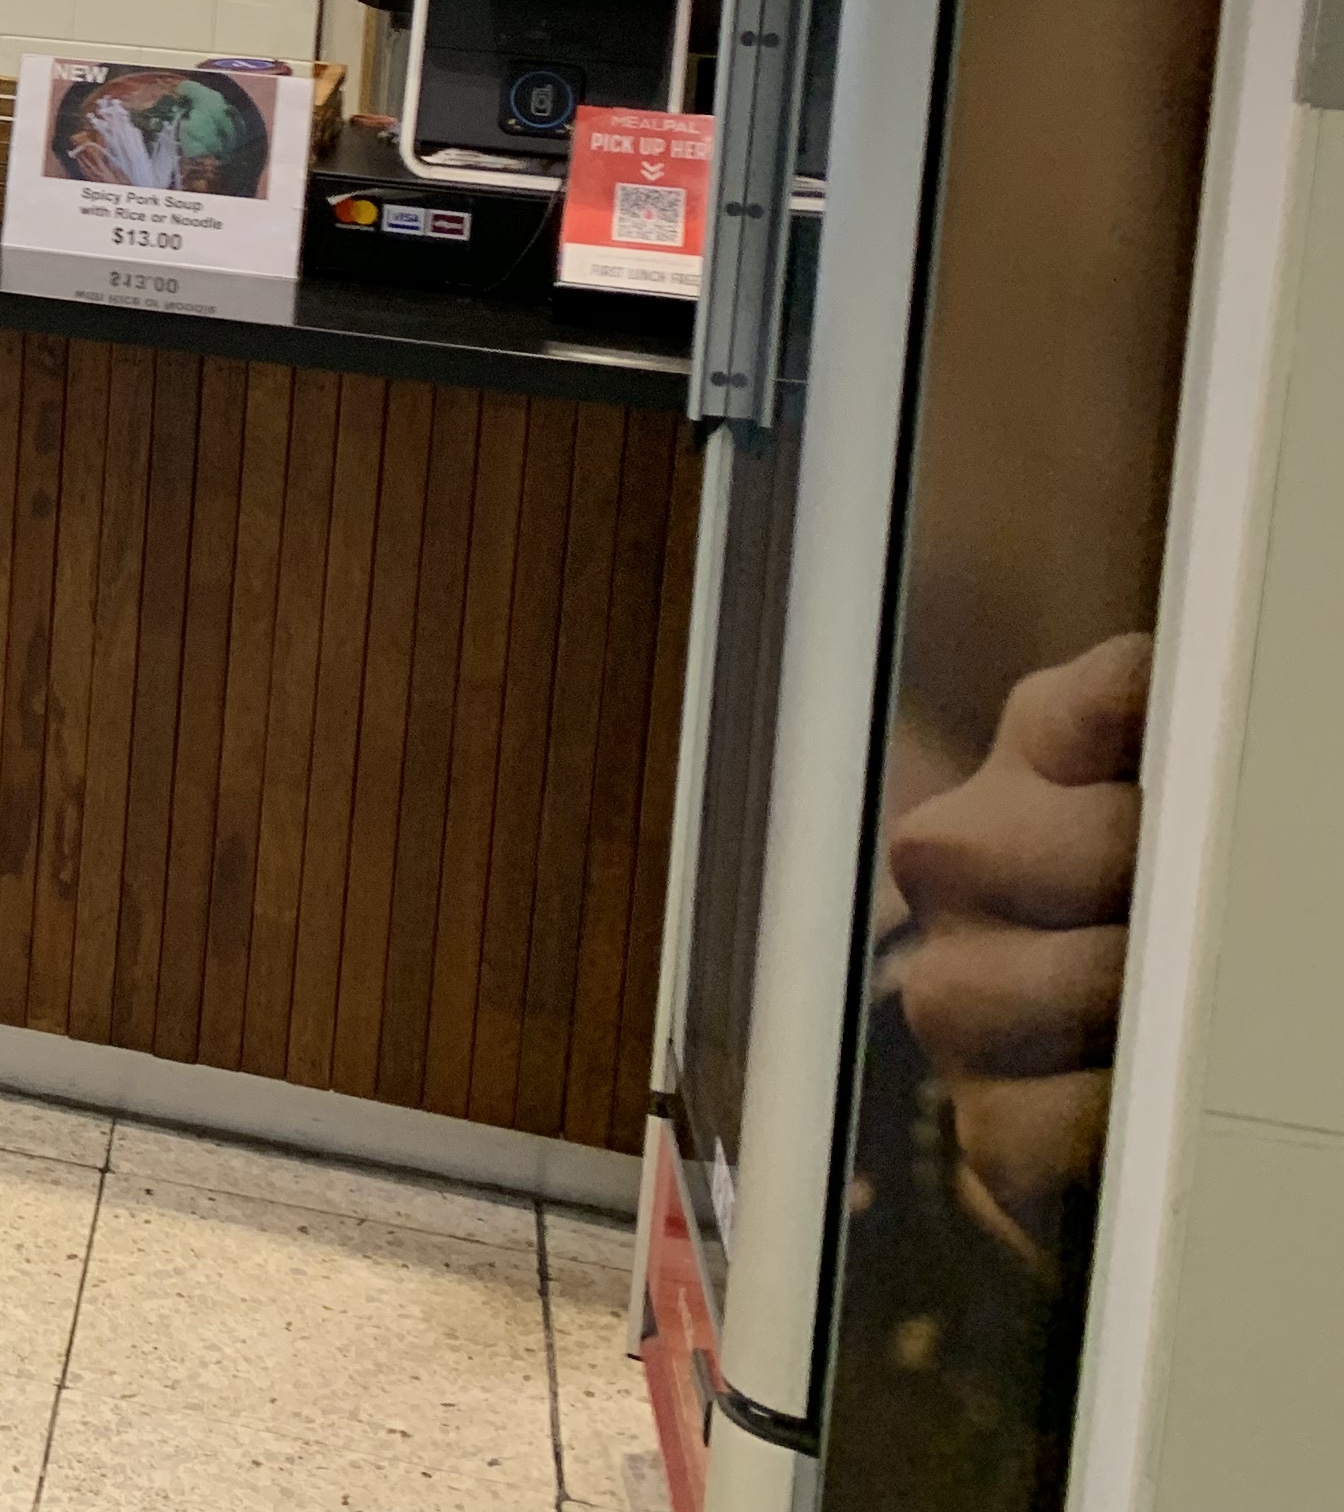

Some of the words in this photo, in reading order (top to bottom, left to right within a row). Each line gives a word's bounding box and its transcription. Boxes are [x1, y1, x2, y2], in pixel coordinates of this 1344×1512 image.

[53, 64, 110, 84] NEW
[611, 115, 701, 134] MEALPAL
[591, 132, 635, 154] PICK
[639, 136, 667, 156] UP
[670, 139, 708, 160] HER
[81, 187, 122, 205] Spicy
[127, 192, 160, 208] Pork
[164, 195, 204, 213] Soup
[79, 204, 111, 219] with
[115, 207, 146, 223] Rice
[150, 213, 167, 224] or
[171, 213, 223, 231] Noodle
[112, 227, 183, 251] $13.00
